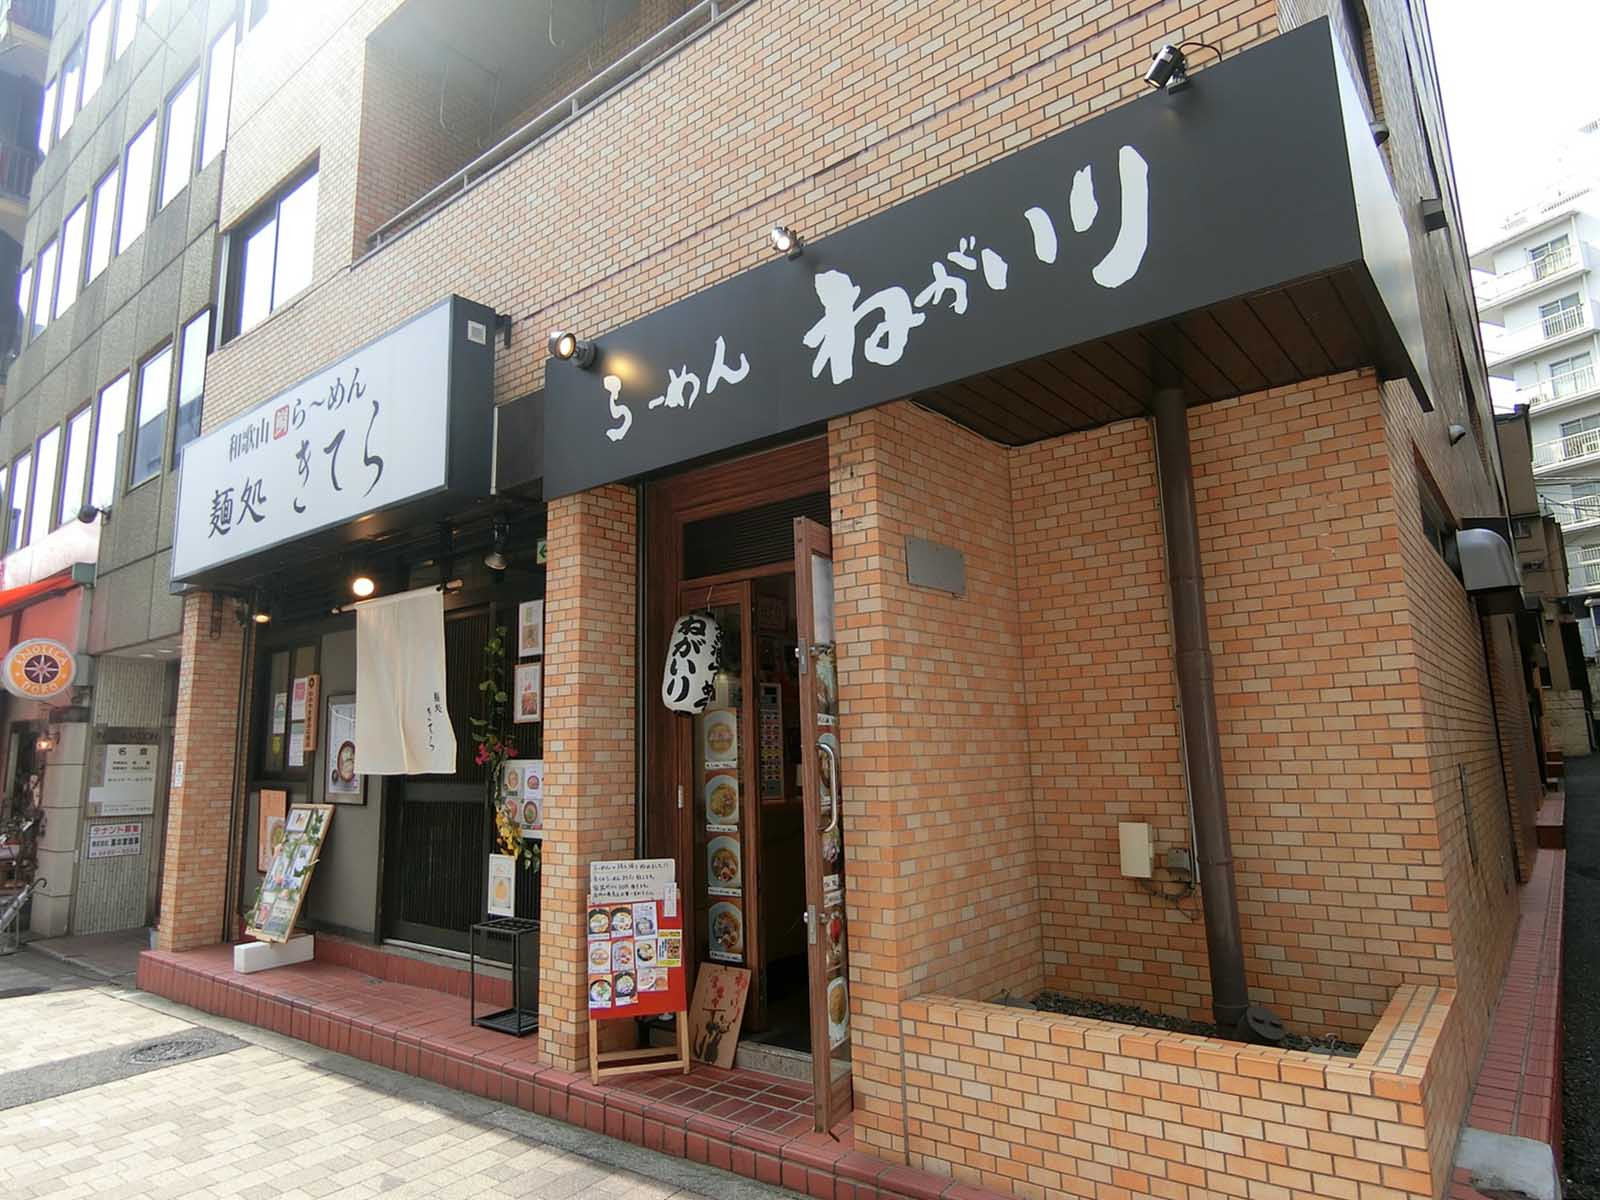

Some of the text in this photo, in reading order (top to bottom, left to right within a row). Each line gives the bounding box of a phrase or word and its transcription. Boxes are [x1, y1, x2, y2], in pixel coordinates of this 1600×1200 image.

[603, 145, 1148, 441] らーめん ねがいり
[208, 400, 384, 538] 麺処 きてら
[229, 418, 269, 462] 和歌山
[667, 616, 706, 702] ねがいり
